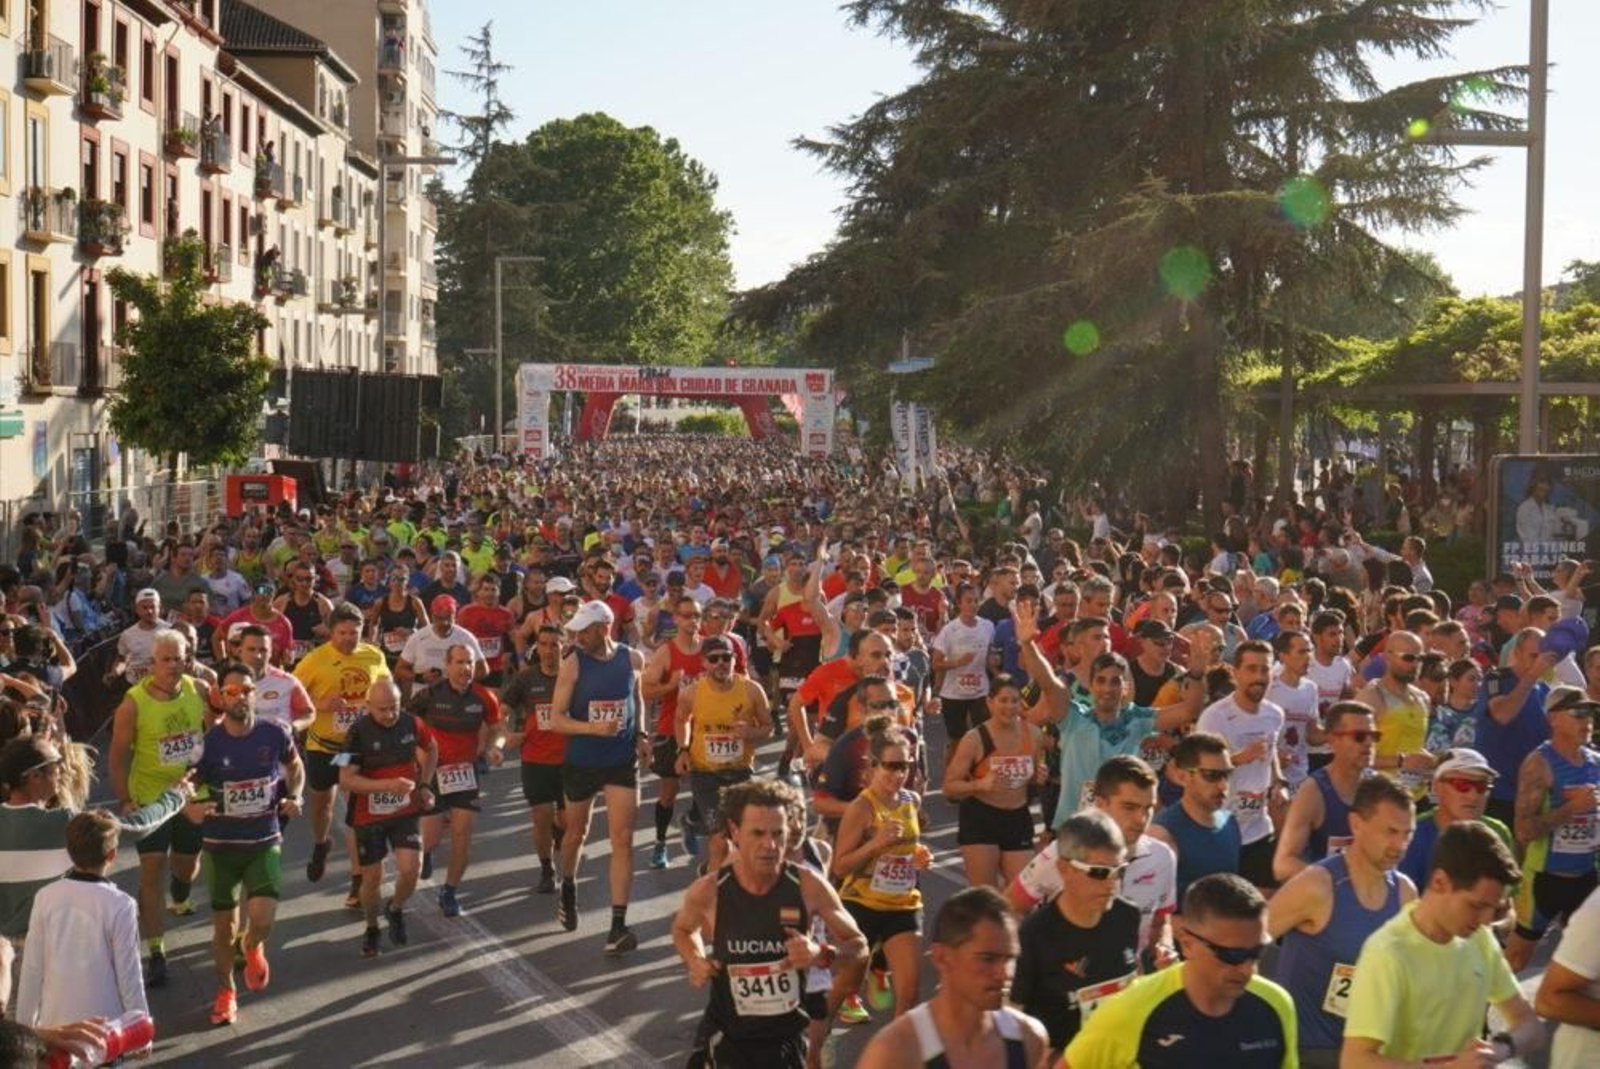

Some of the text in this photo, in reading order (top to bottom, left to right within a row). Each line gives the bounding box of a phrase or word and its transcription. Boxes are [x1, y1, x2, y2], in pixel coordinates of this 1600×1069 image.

[554, 366, 576, 389] 38
[579, 376, 614, 391] MEDIA
[680, 377, 721, 393] CIUDAD
[725, 378, 738, 393] DE
[742, 378, 797, 394] GRANADA
[1523, 542, 1538, 553] ES
[1543, 541, 1586, 553] TENER
[164, 738, 194, 756] 2435
[709, 742, 739, 754] 1716
[442, 771, 468, 784] 2311
[229, 787, 265, 803] 2434
[738, 972, 791, 998] 3416
[1336, 978, 1352, 998] 2
